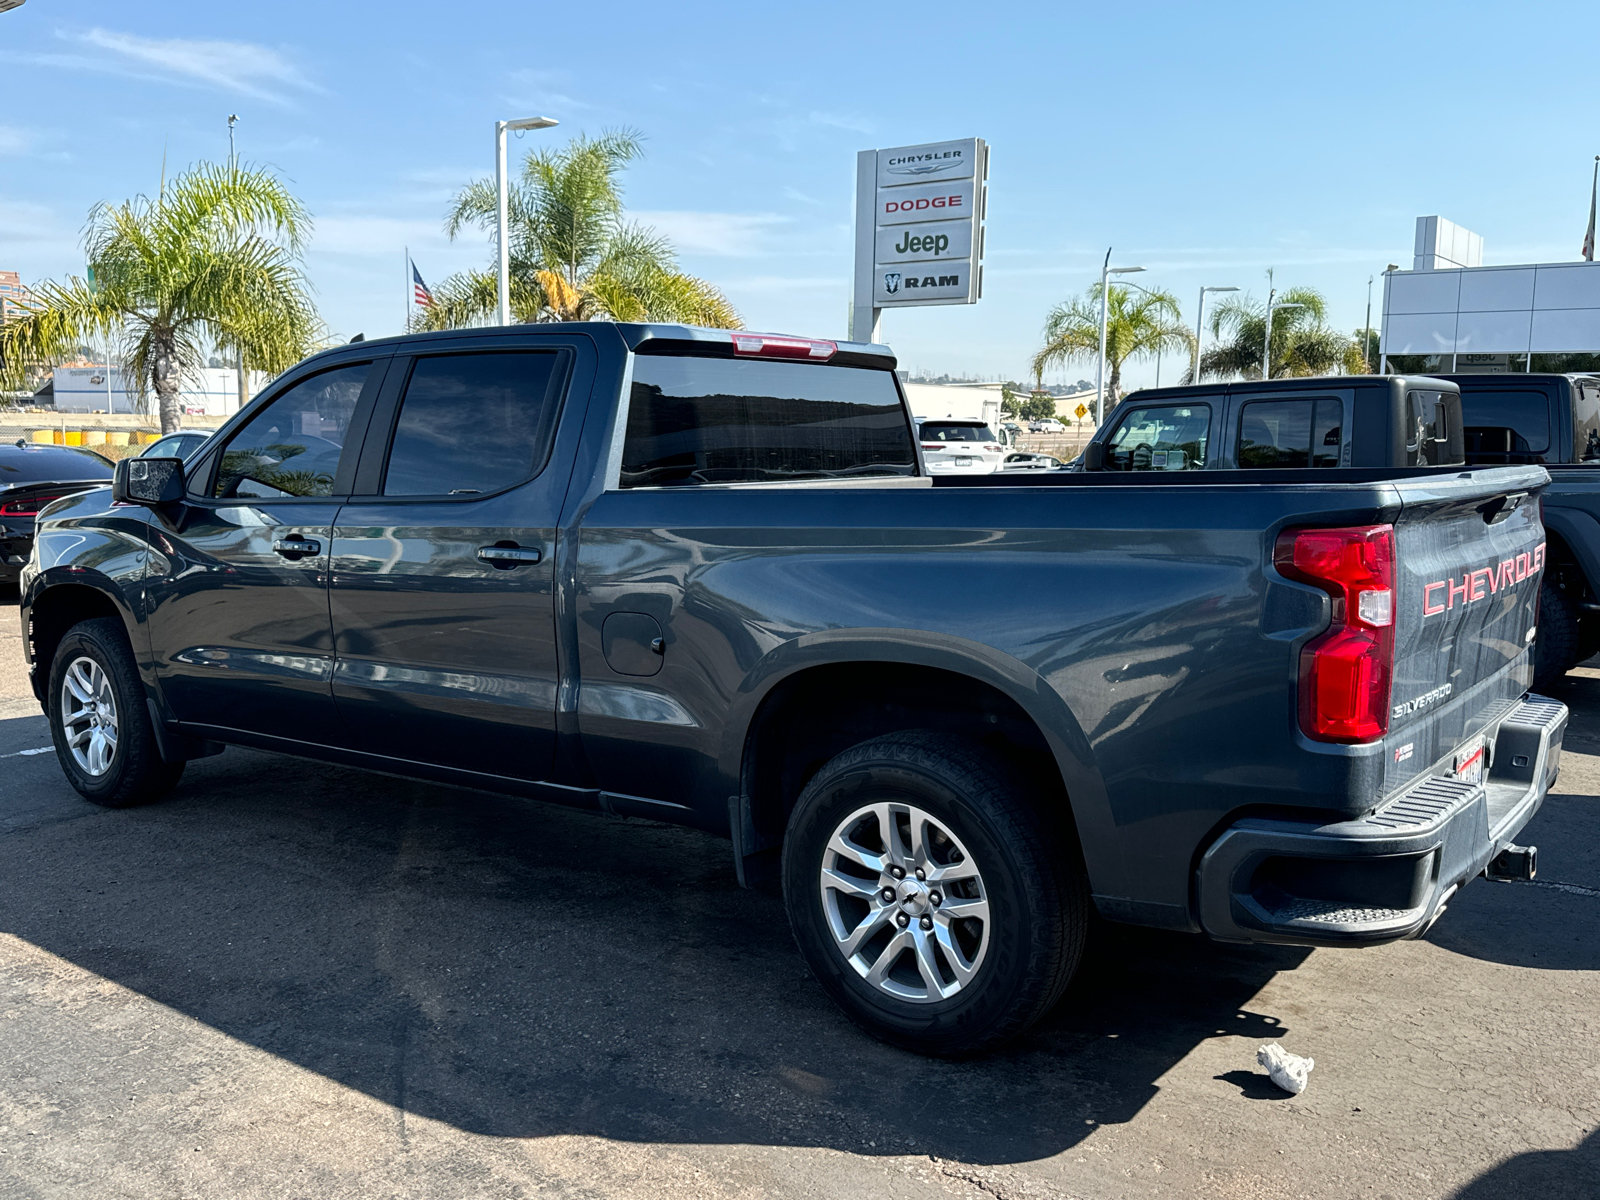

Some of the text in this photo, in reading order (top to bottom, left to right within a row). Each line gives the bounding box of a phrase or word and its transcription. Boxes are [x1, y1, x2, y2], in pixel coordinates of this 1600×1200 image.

[889, 150, 962, 165] CHRYSLER
[885, 195, 962, 213] DODGE
[895, 231, 949, 255] Jeep
[905, 275, 959, 288] RAM
[1423, 542, 1546, 617] CHEVROLET
[1392, 682, 1452, 719] SILVERADO
